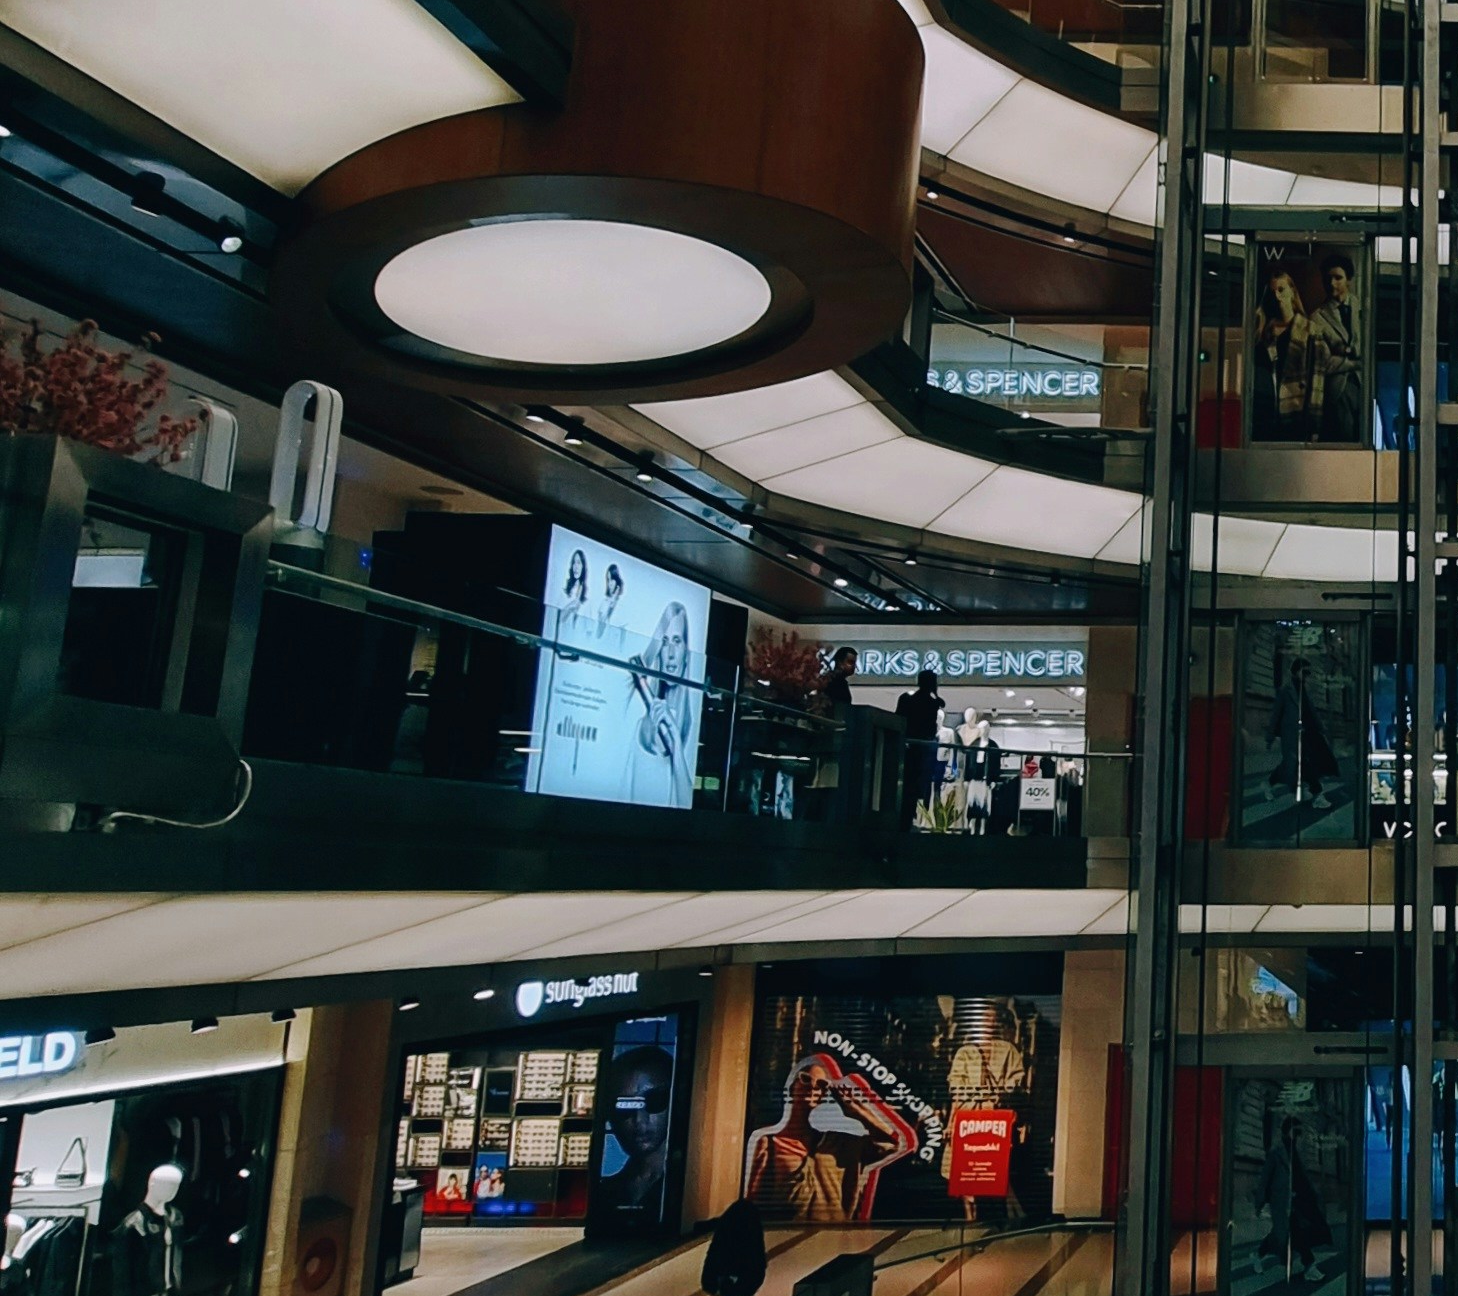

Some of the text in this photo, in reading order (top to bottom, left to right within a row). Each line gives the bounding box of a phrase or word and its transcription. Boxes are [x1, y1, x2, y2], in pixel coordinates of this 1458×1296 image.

[965, 369, 1099, 396] SPENCER
[947, 650, 1085, 676] SPENCER
[1025, 787, 1050, 798] 40%
[0, 1031, 77, 1078] ELD
[813, 1030, 897, 1085] NON-STOP
[959, 1119, 1007, 1138] CAMPER
